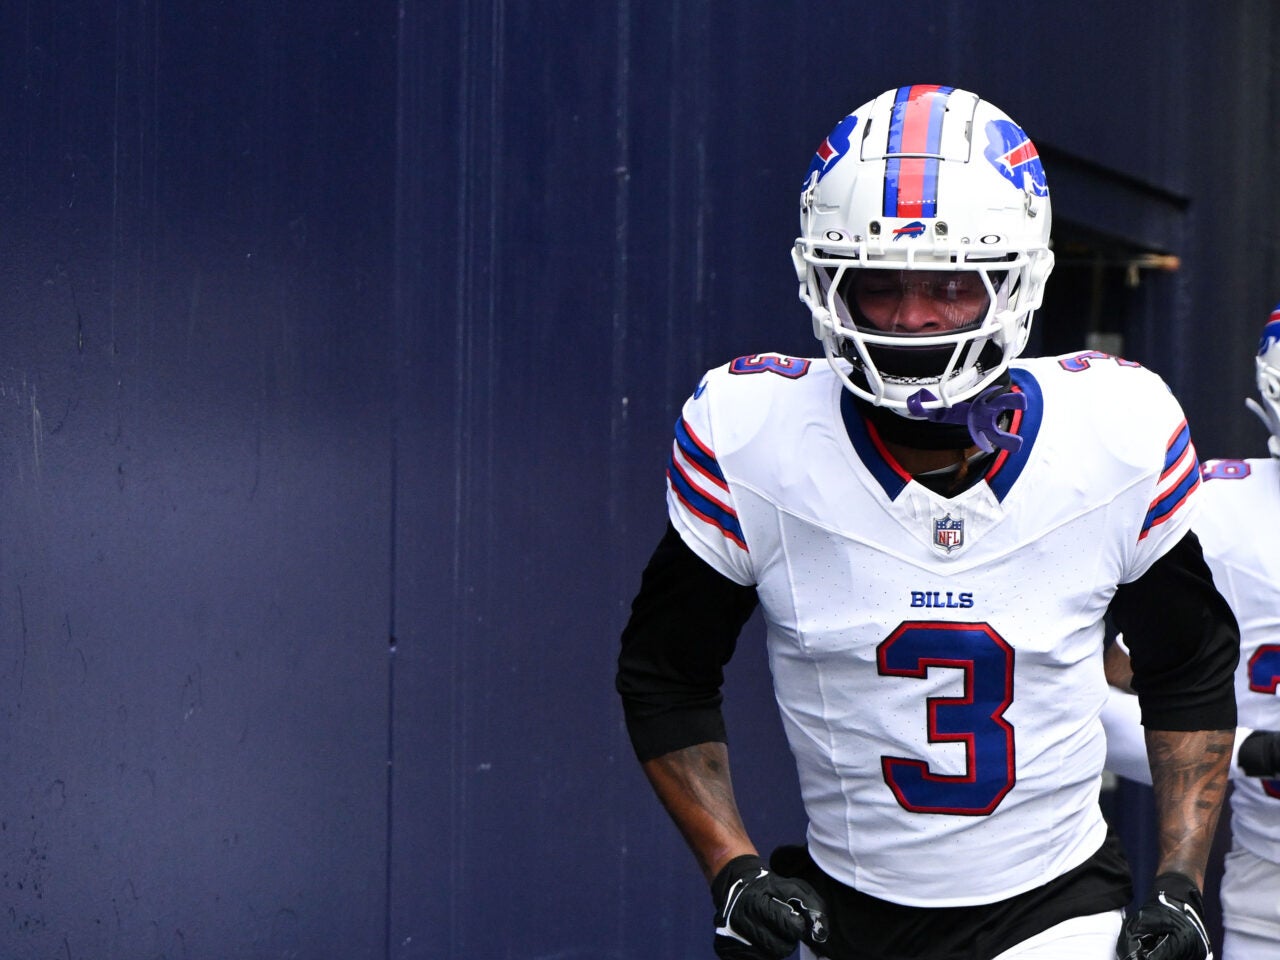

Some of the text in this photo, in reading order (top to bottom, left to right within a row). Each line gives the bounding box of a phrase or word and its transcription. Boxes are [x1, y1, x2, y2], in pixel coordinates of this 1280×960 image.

[938, 531, 960, 546] NFL
[910, 591, 974, 608] BILLS
[876, 620, 1016, 817] 3
